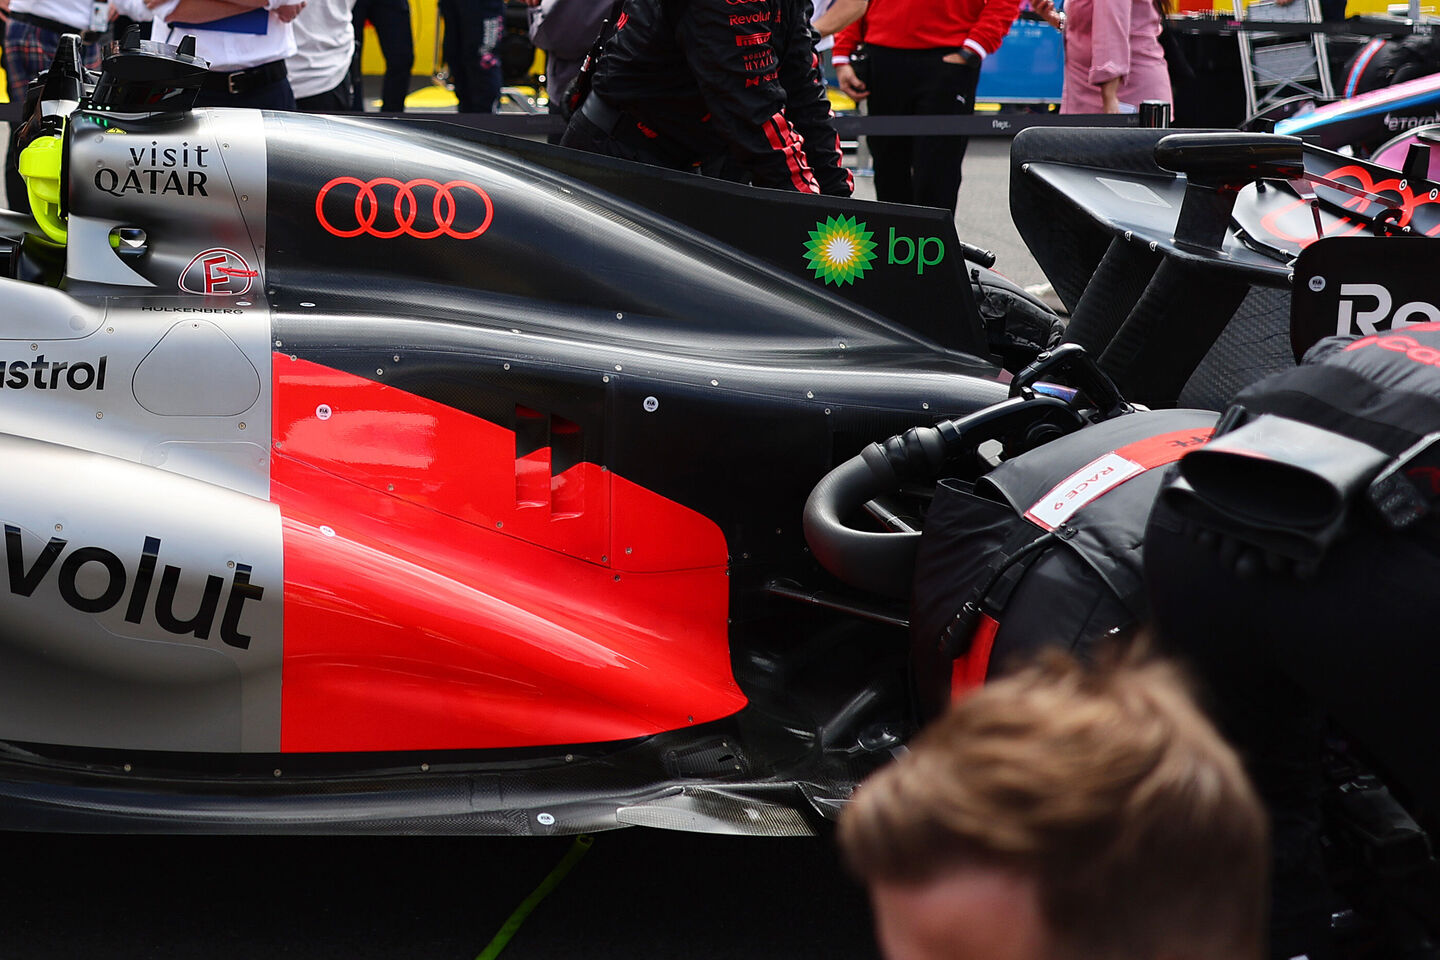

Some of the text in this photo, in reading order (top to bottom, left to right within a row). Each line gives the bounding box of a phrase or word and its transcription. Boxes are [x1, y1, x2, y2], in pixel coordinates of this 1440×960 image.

[129, 140, 209, 168] visit
[94, 168, 209, 198] QATAR
[887, 226, 945, 275] bp
[141, 306, 244, 315] HULKENBERG
[1064, 466, 1115, 500] RACE
